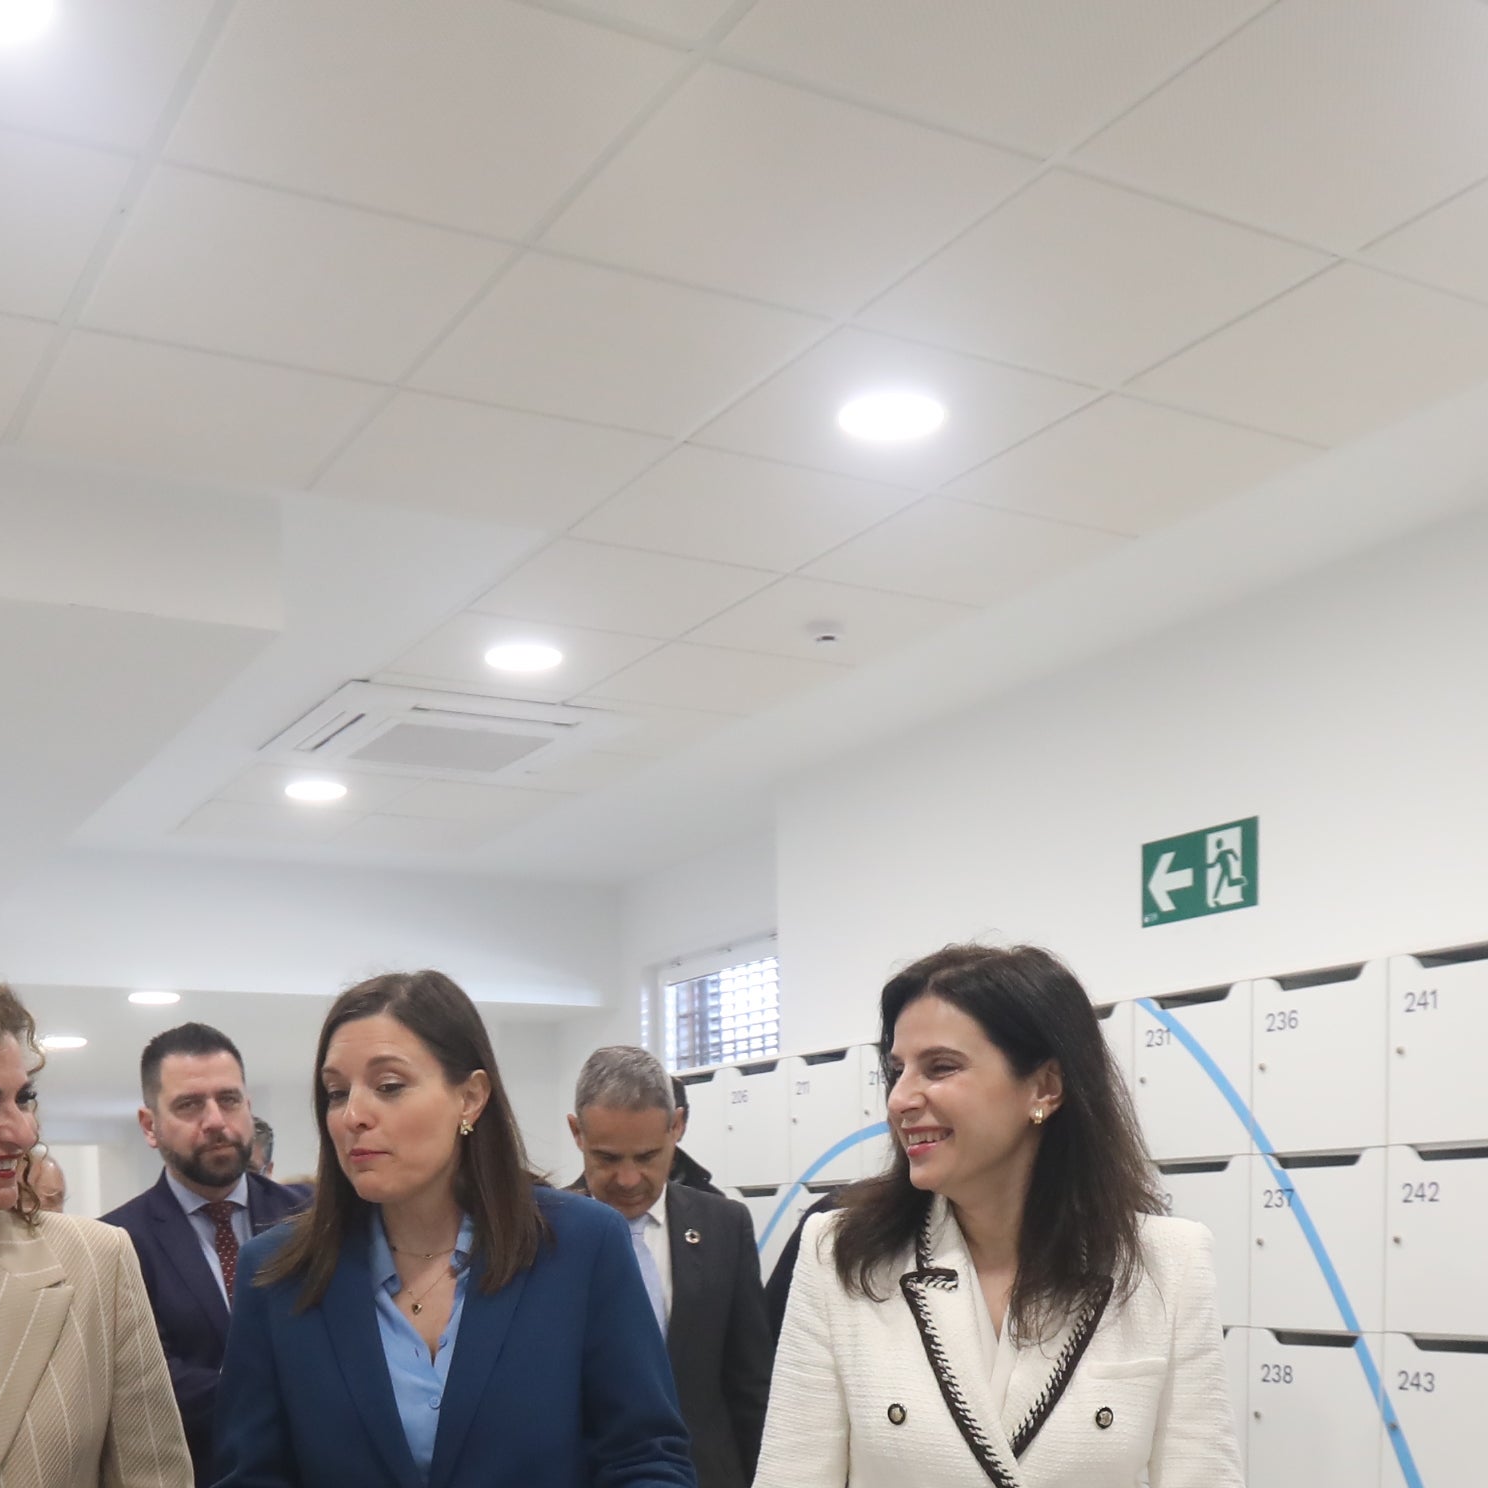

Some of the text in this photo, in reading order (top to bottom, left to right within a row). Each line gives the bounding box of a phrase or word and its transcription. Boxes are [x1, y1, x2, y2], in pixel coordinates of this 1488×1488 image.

[1404, 989, 1438, 1013] 241
[1265, 1009, 1299, 1033] 236
[1145, 1027, 1171, 1047] 231
[1263, 1187, 1295, 1209] 237
[1402, 1181, 1440, 1204] 242
[1261, 1363, 1294, 1385] 238
[1397, 1370, 1435, 1393] 243
